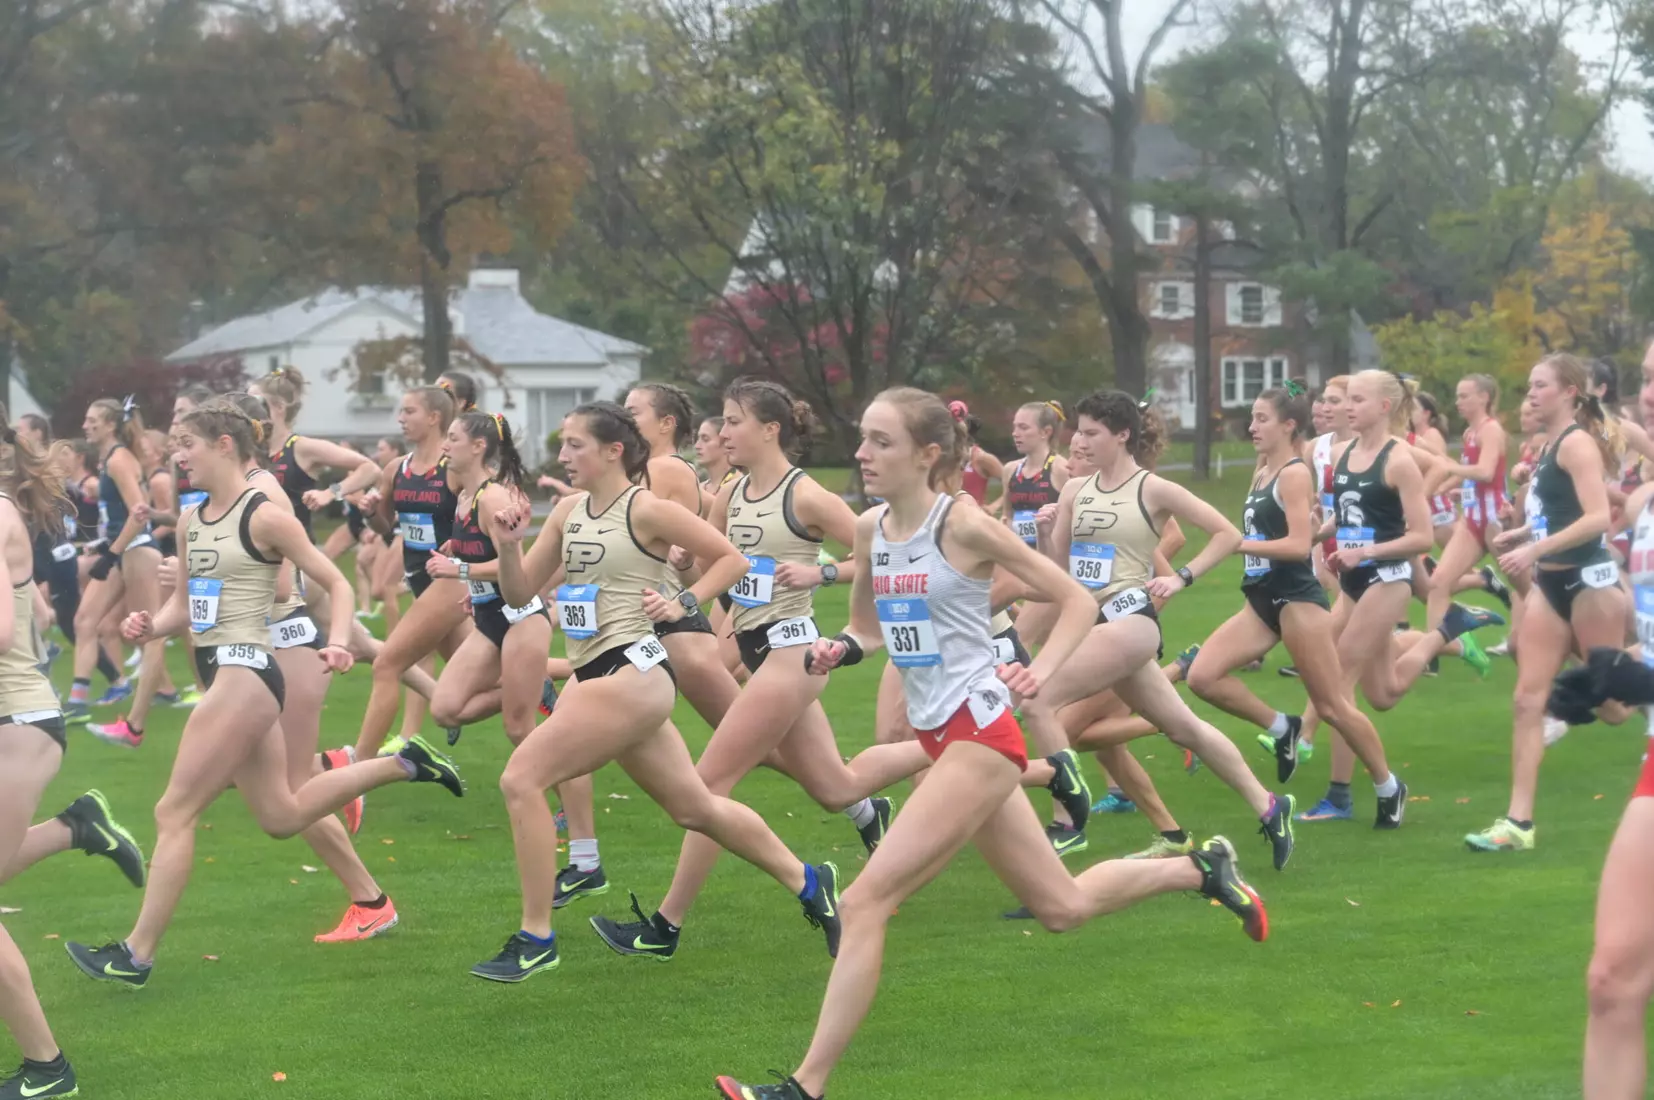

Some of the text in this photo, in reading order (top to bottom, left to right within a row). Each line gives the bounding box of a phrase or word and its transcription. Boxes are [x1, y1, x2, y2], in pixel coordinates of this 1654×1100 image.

[1017, 522, 1036, 536] 266
[1073, 509, 1118, 537] P
[565, 541, 606, 573] P
[1076, 559, 1102, 580] 358
[735, 576, 758, 598] 361
[894, 573, 928, 593] STATE
[191, 599, 209, 620] 359
[1112, 593, 1137, 613] 358
[564, 605, 586, 628] 363
[280, 623, 306, 641] 360
[781, 622, 807, 639] 361
[891, 626, 920, 652] 337
[228, 644, 255, 660] 359
